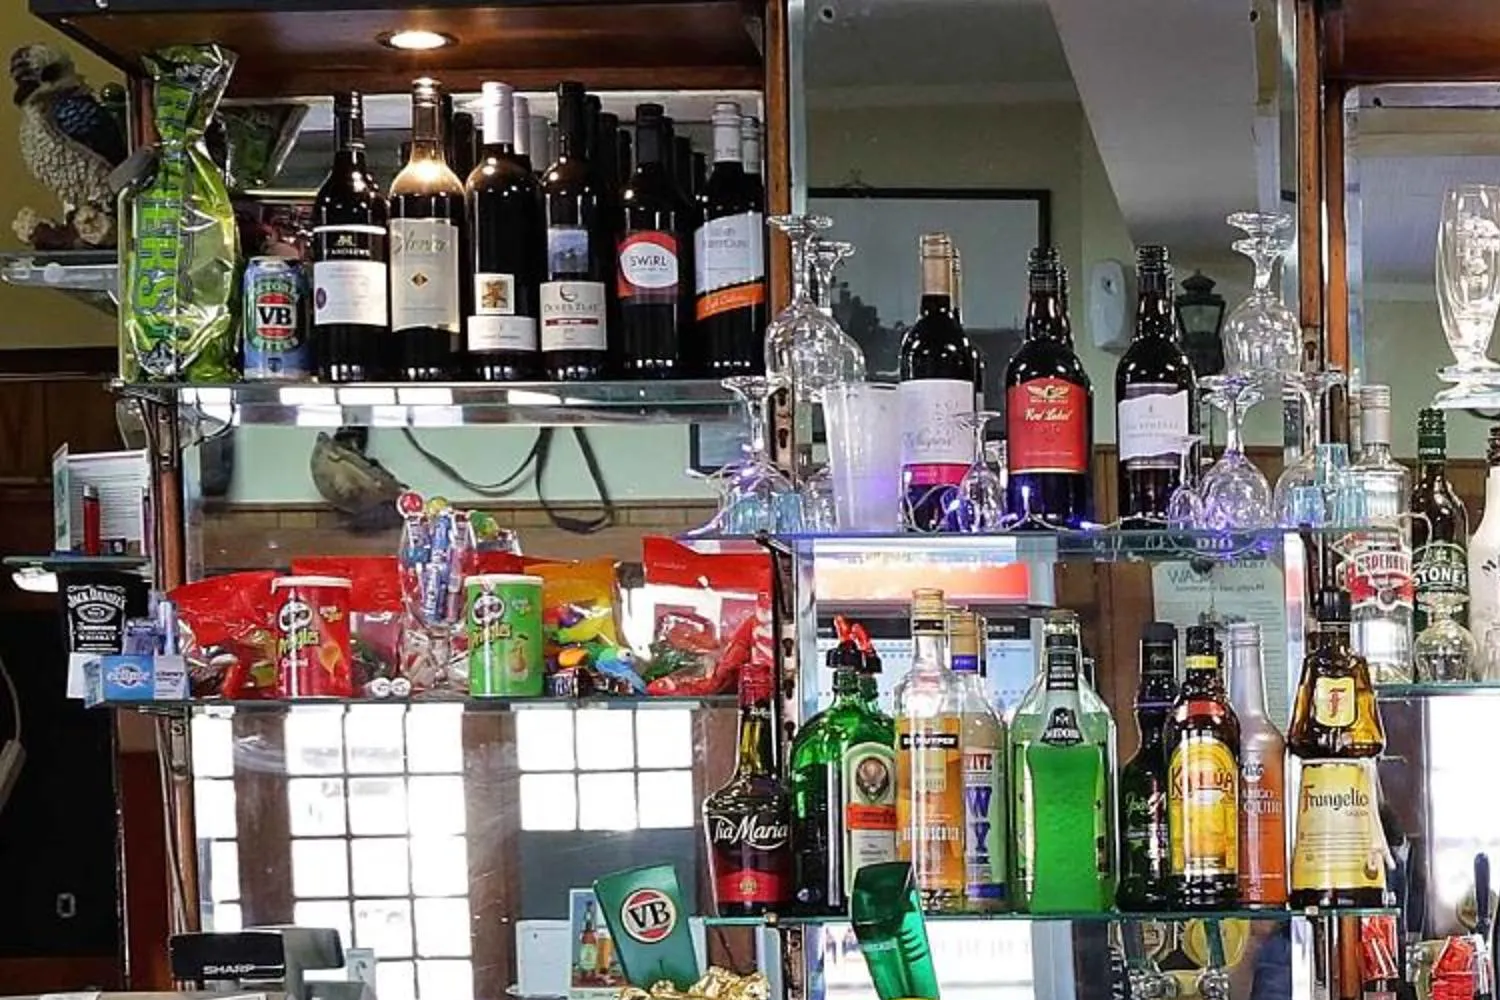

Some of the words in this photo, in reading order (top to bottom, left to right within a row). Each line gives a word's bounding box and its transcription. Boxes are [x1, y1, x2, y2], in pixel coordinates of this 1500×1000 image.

[258, 306, 293, 325] VB
[628, 901, 672, 929] VB
[203, 964, 255, 975] SHARP
